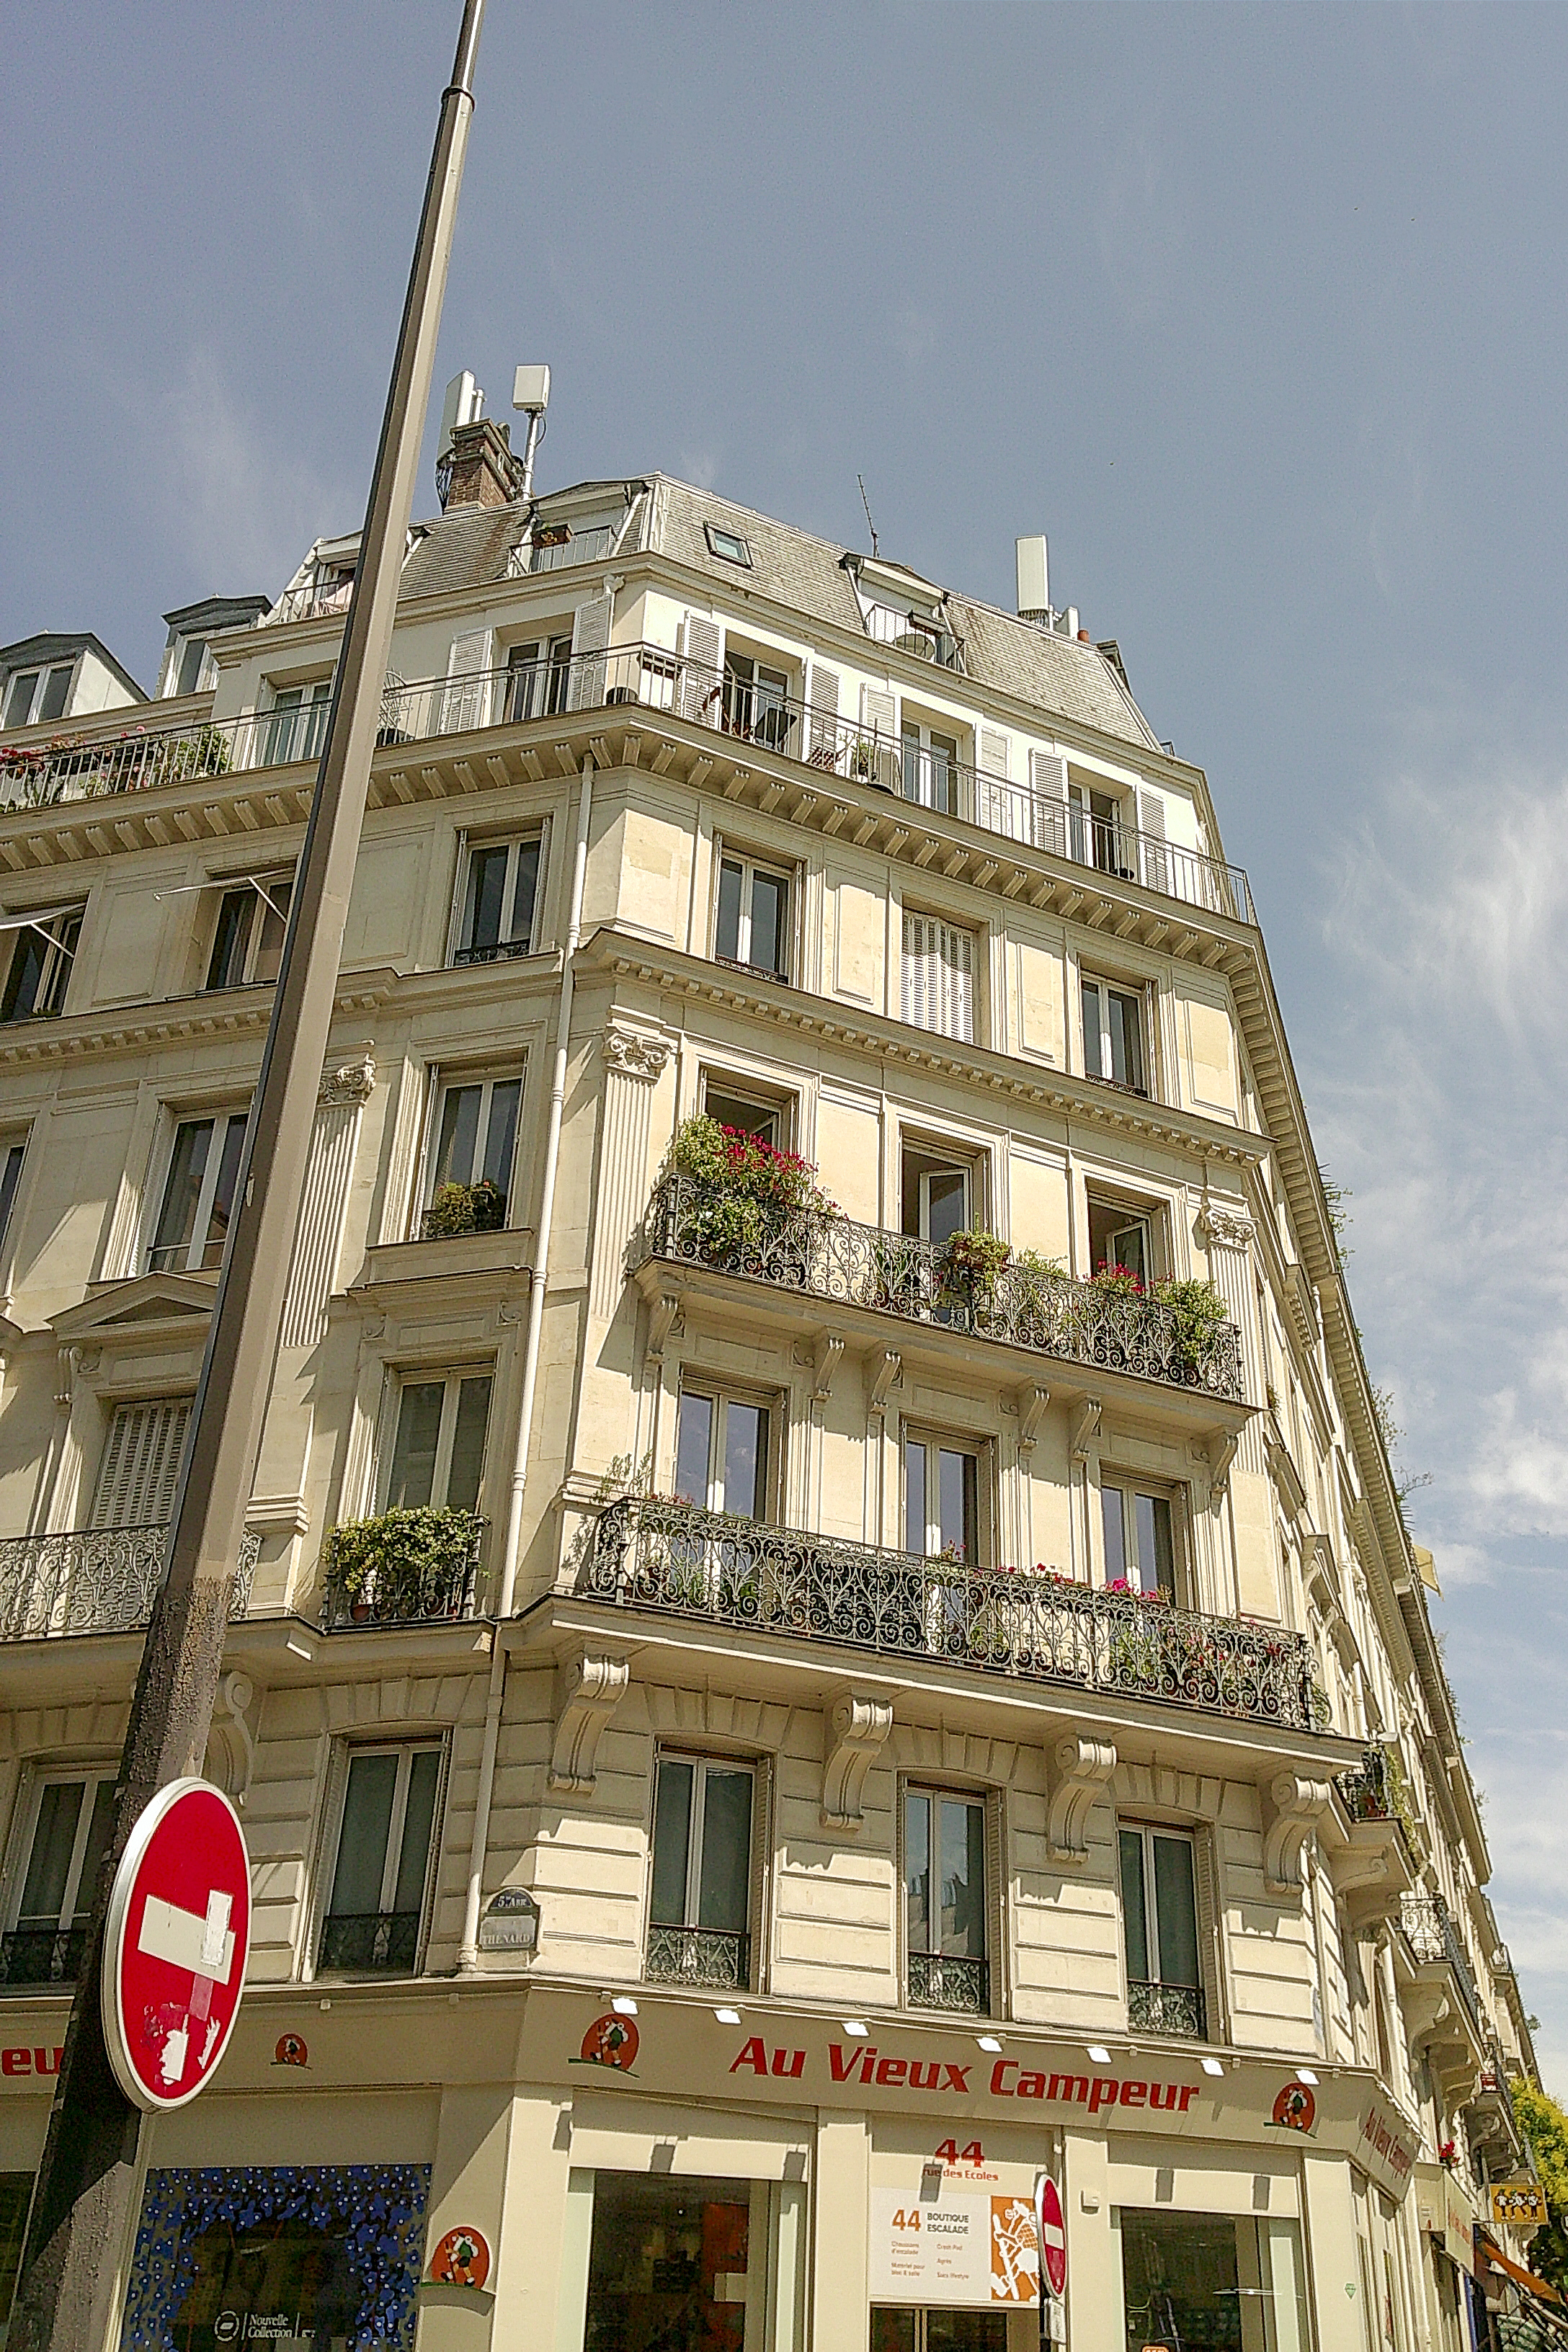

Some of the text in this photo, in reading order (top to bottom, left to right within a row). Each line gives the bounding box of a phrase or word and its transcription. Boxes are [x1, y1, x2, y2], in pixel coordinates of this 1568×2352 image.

[728, 2036, 1200, 2114] Au Vieux Campeur
[934, 2138, 985, 2168] 44
[922, 2168, 942, 2177] rue
[943, 2168, 963, 2178] des
[891, 2209, 922, 2232] 44
[927, 2212, 969, 2224] BOUTIQUE
[927, 2224, 969, 2235] ESCALADE
[249, 2313, 289, 2326] Nouvelle
[248, 2326, 293, 2338] Collection
